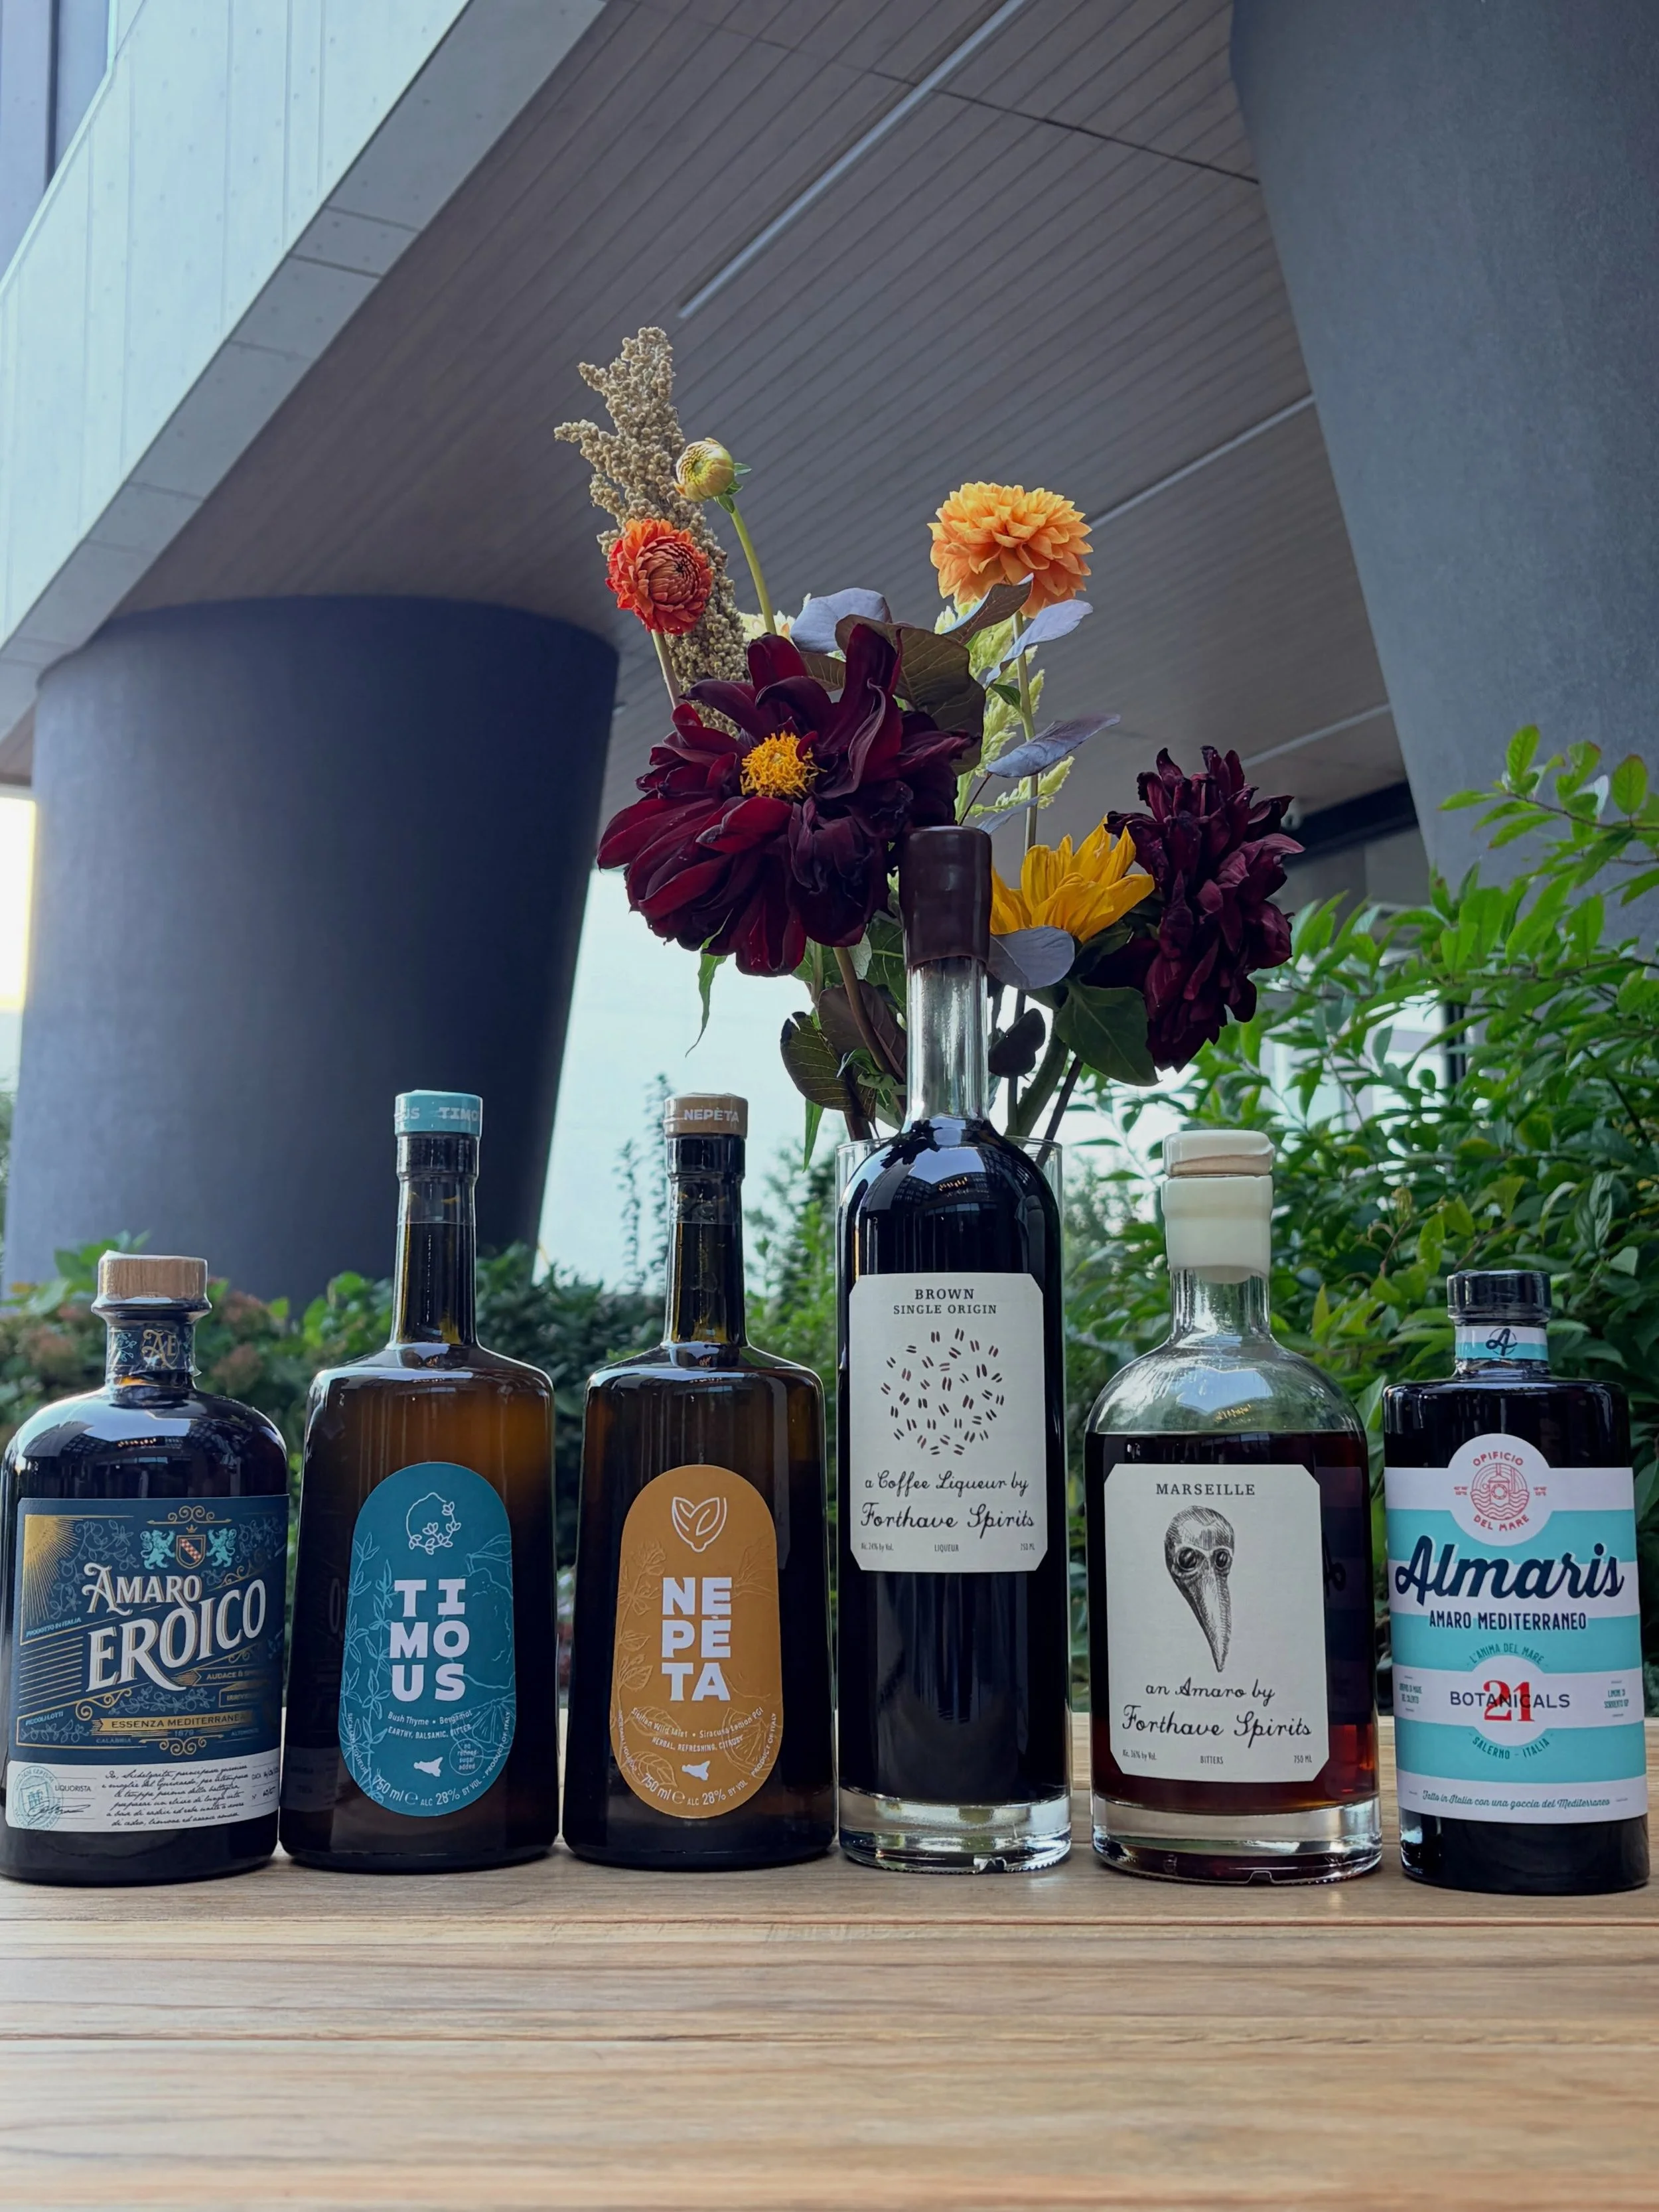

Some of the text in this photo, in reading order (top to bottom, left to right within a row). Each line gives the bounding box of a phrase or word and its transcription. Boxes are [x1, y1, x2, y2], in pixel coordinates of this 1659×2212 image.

[438, 1107, 480, 1122] TIMO
[914, 1289, 974, 1299] BROWN
[893, 1304, 997, 1315] SINGLE ORIGIN
[1473, 1451, 1523, 1466] OPIFICIO
[865, 1469, 1029, 1497] a Coffee Liqueur by
[1156, 1484, 1255, 1495] MARSEILLE
[861, 1502, 1035, 1539] Forthave Spirits
[1474, 1514, 1529, 1531] DEL MARE
[1395, 1535, 1625, 1607] Almaris
[81, 1562, 202, 1616] AMARO
[1429, 1610, 1586, 1631] AMARO MEDITERRANEO
[86, 1579, 265, 1691] EROICO
[1469, 1643, 1544, 1664] L'ANIMA DEL MARE
[1146, 1677, 1275, 1706] an Amaro by
[1450, 1691, 1570, 1708] BOTANICALS
[1482, 1680, 1535, 1722] 21
[111, 1719, 165, 1728] ESSENZA
[388, 1710, 472, 1727] Bush Thyme Bergamot
[631, 1707, 653, 1728] Sicilian
[654, 1722, 670, 1735] Wild
[699, 1727, 730, 1739] Siracusa
[752, 1707, 764, 1719] PGI
[1121, 1704, 1312, 1749] Forthave Spirits
[450, 1724, 472, 1736] BITTER
[751, 1744, 770, 1777] PRODUCT
[768, 1732, 774, 1743] OF
[1473, 1737, 1550, 1759] SALERNO ITALIA
[484, 1743, 504, 1776] PRODUCT
[1200, 1755, 1223, 1764] BITTERS
[372, 1774, 391, 1794] 750
[390, 1788, 404, 1802] ml
[435, 1788, 460, 1805] 28%
[461, 1786, 470, 1796] BY
[469, 1779, 482, 1789] VOL
[641, 1773, 659, 1793] 750
[657, 1788, 672, 1801] ml
[702, 1789, 726, 1805] 28%
[727, 1787, 736, 1797] BY
[736, 1780, 748, 1791] VOL
[1440, 1794, 1448, 1803] in
[1449, 1795, 1473, 1805] Italia
[1510, 1799, 1540, 1810] goccia
[1542, 1799, 1555, 1808] del
[1557, 1799, 1610, 1809] Mediterraneo
